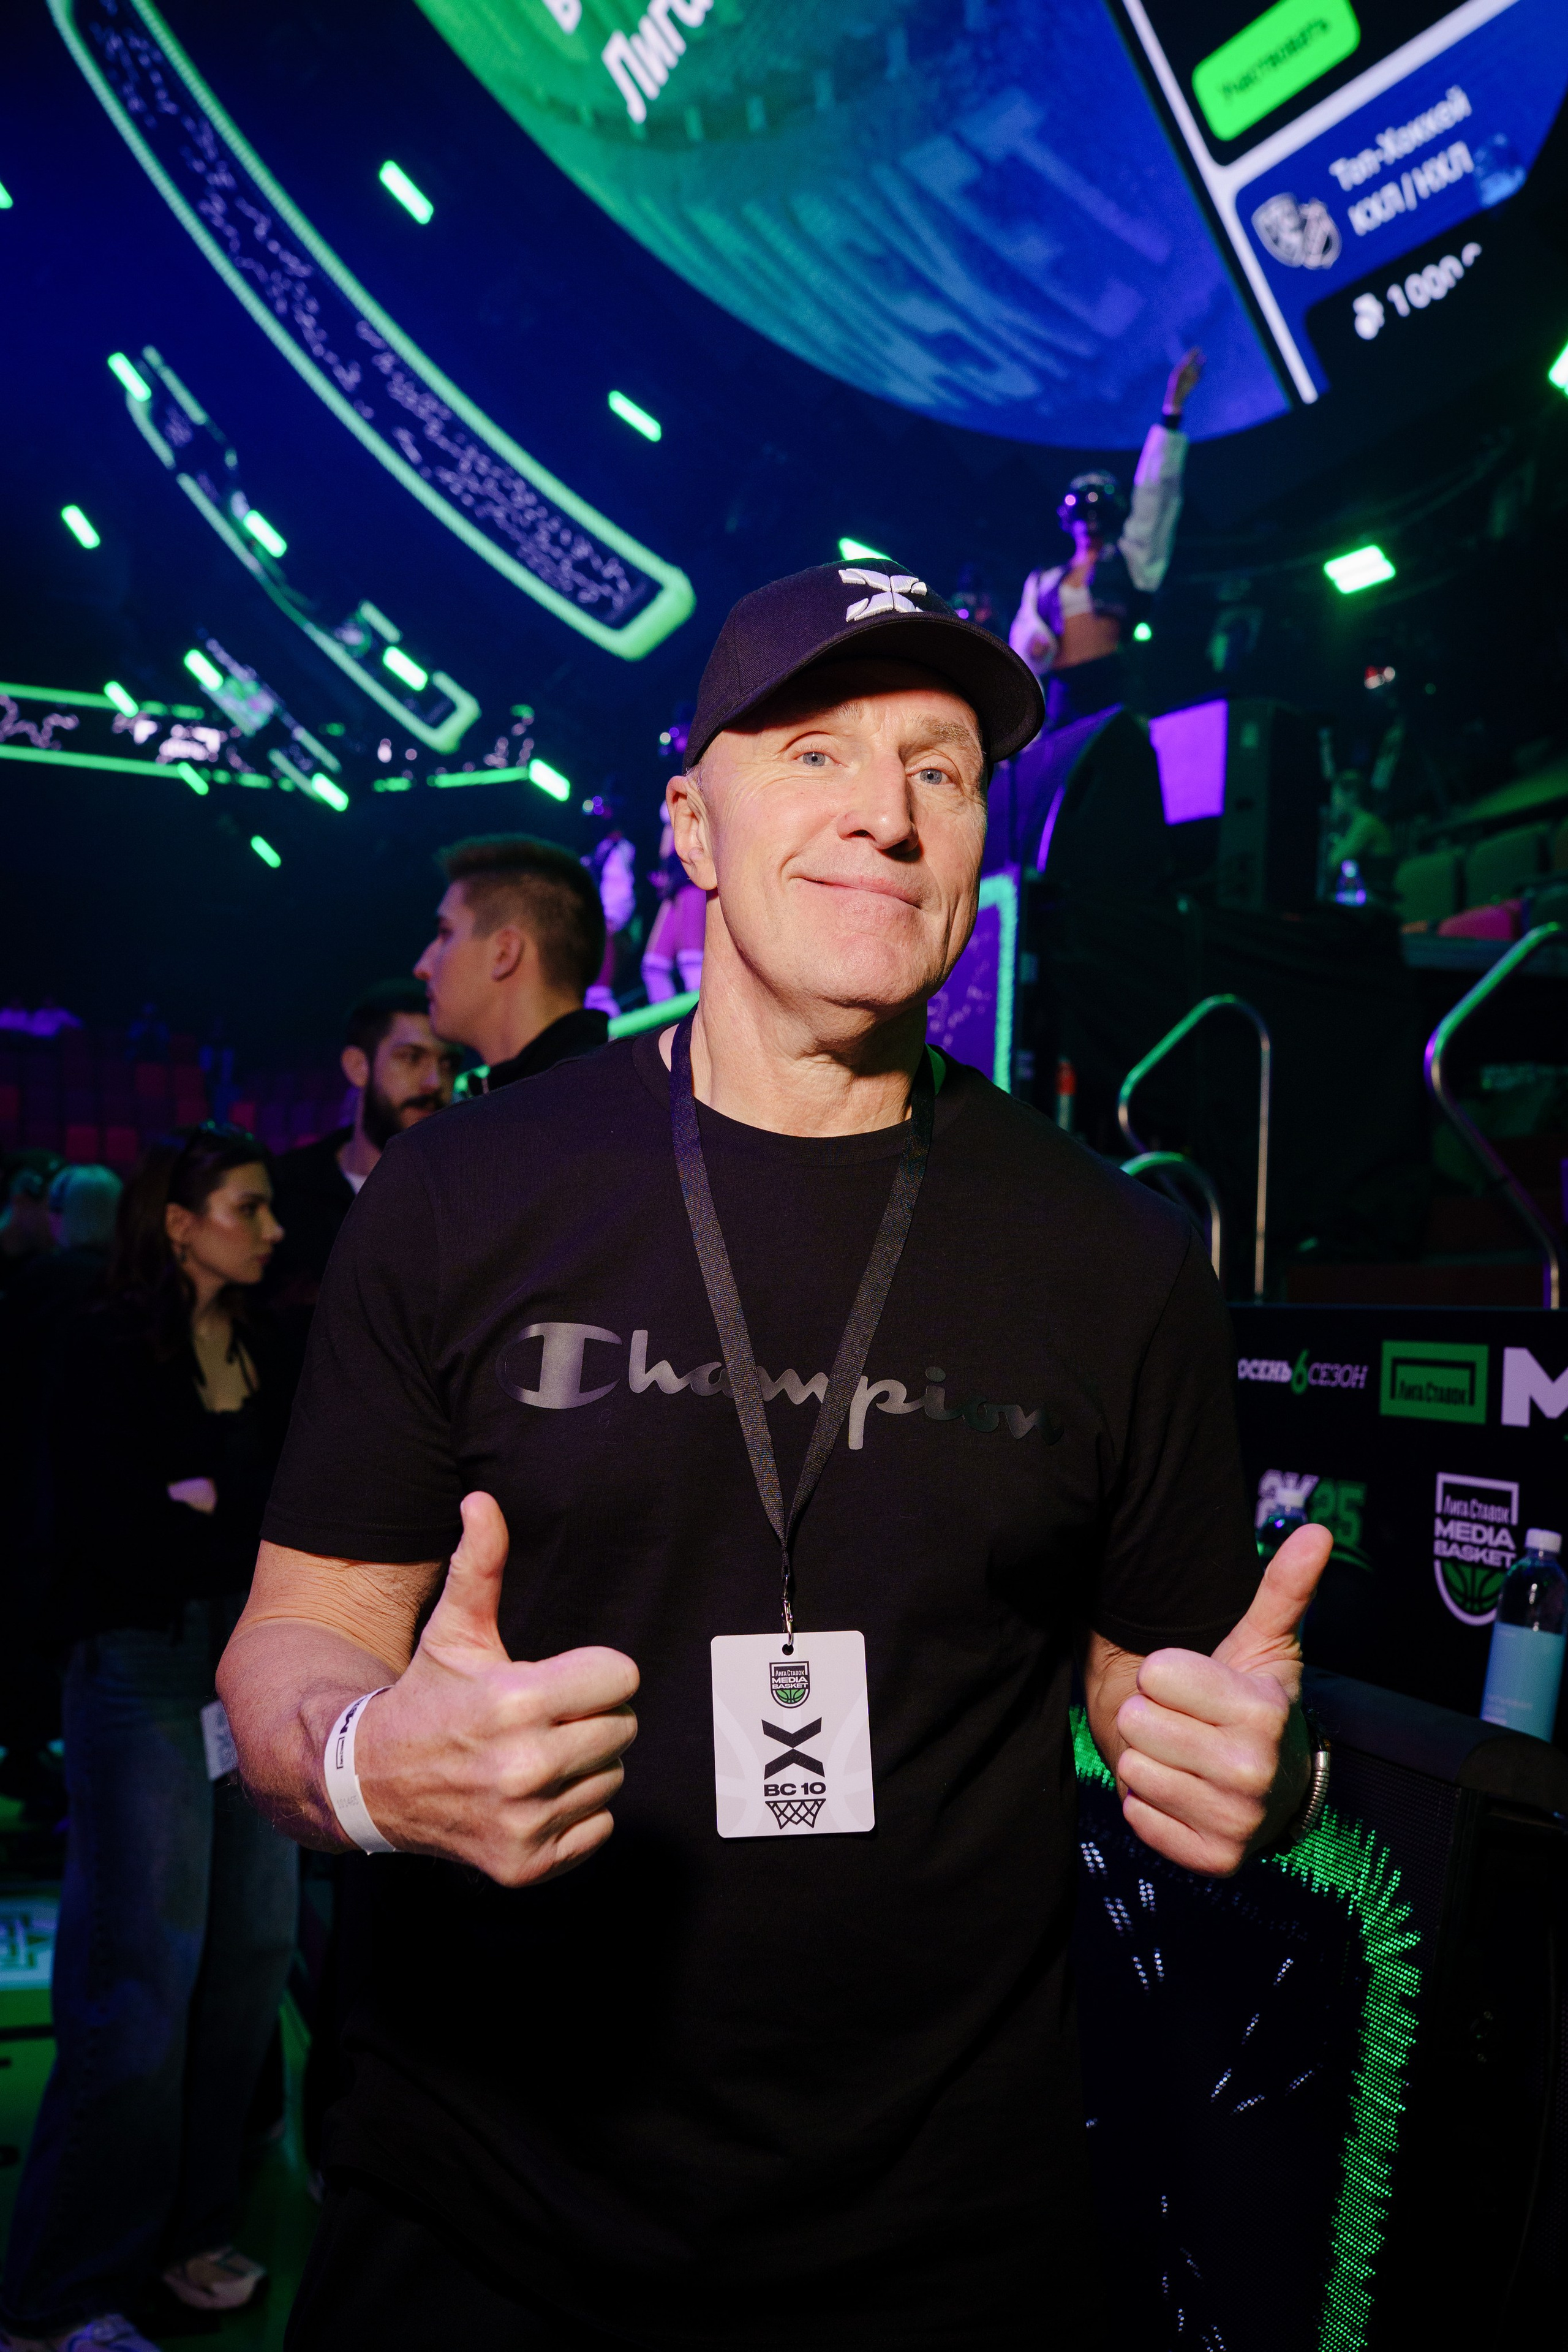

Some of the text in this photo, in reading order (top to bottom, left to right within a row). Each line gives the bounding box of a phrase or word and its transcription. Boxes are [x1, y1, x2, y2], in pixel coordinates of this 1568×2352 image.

[496, 1322, 1064, 1450] Champion
[1434, 1517, 1517, 1551] MEDIA
[1433, 1539, 1517, 1570] BASKET
[801, 1782, 826, 1795] 10
